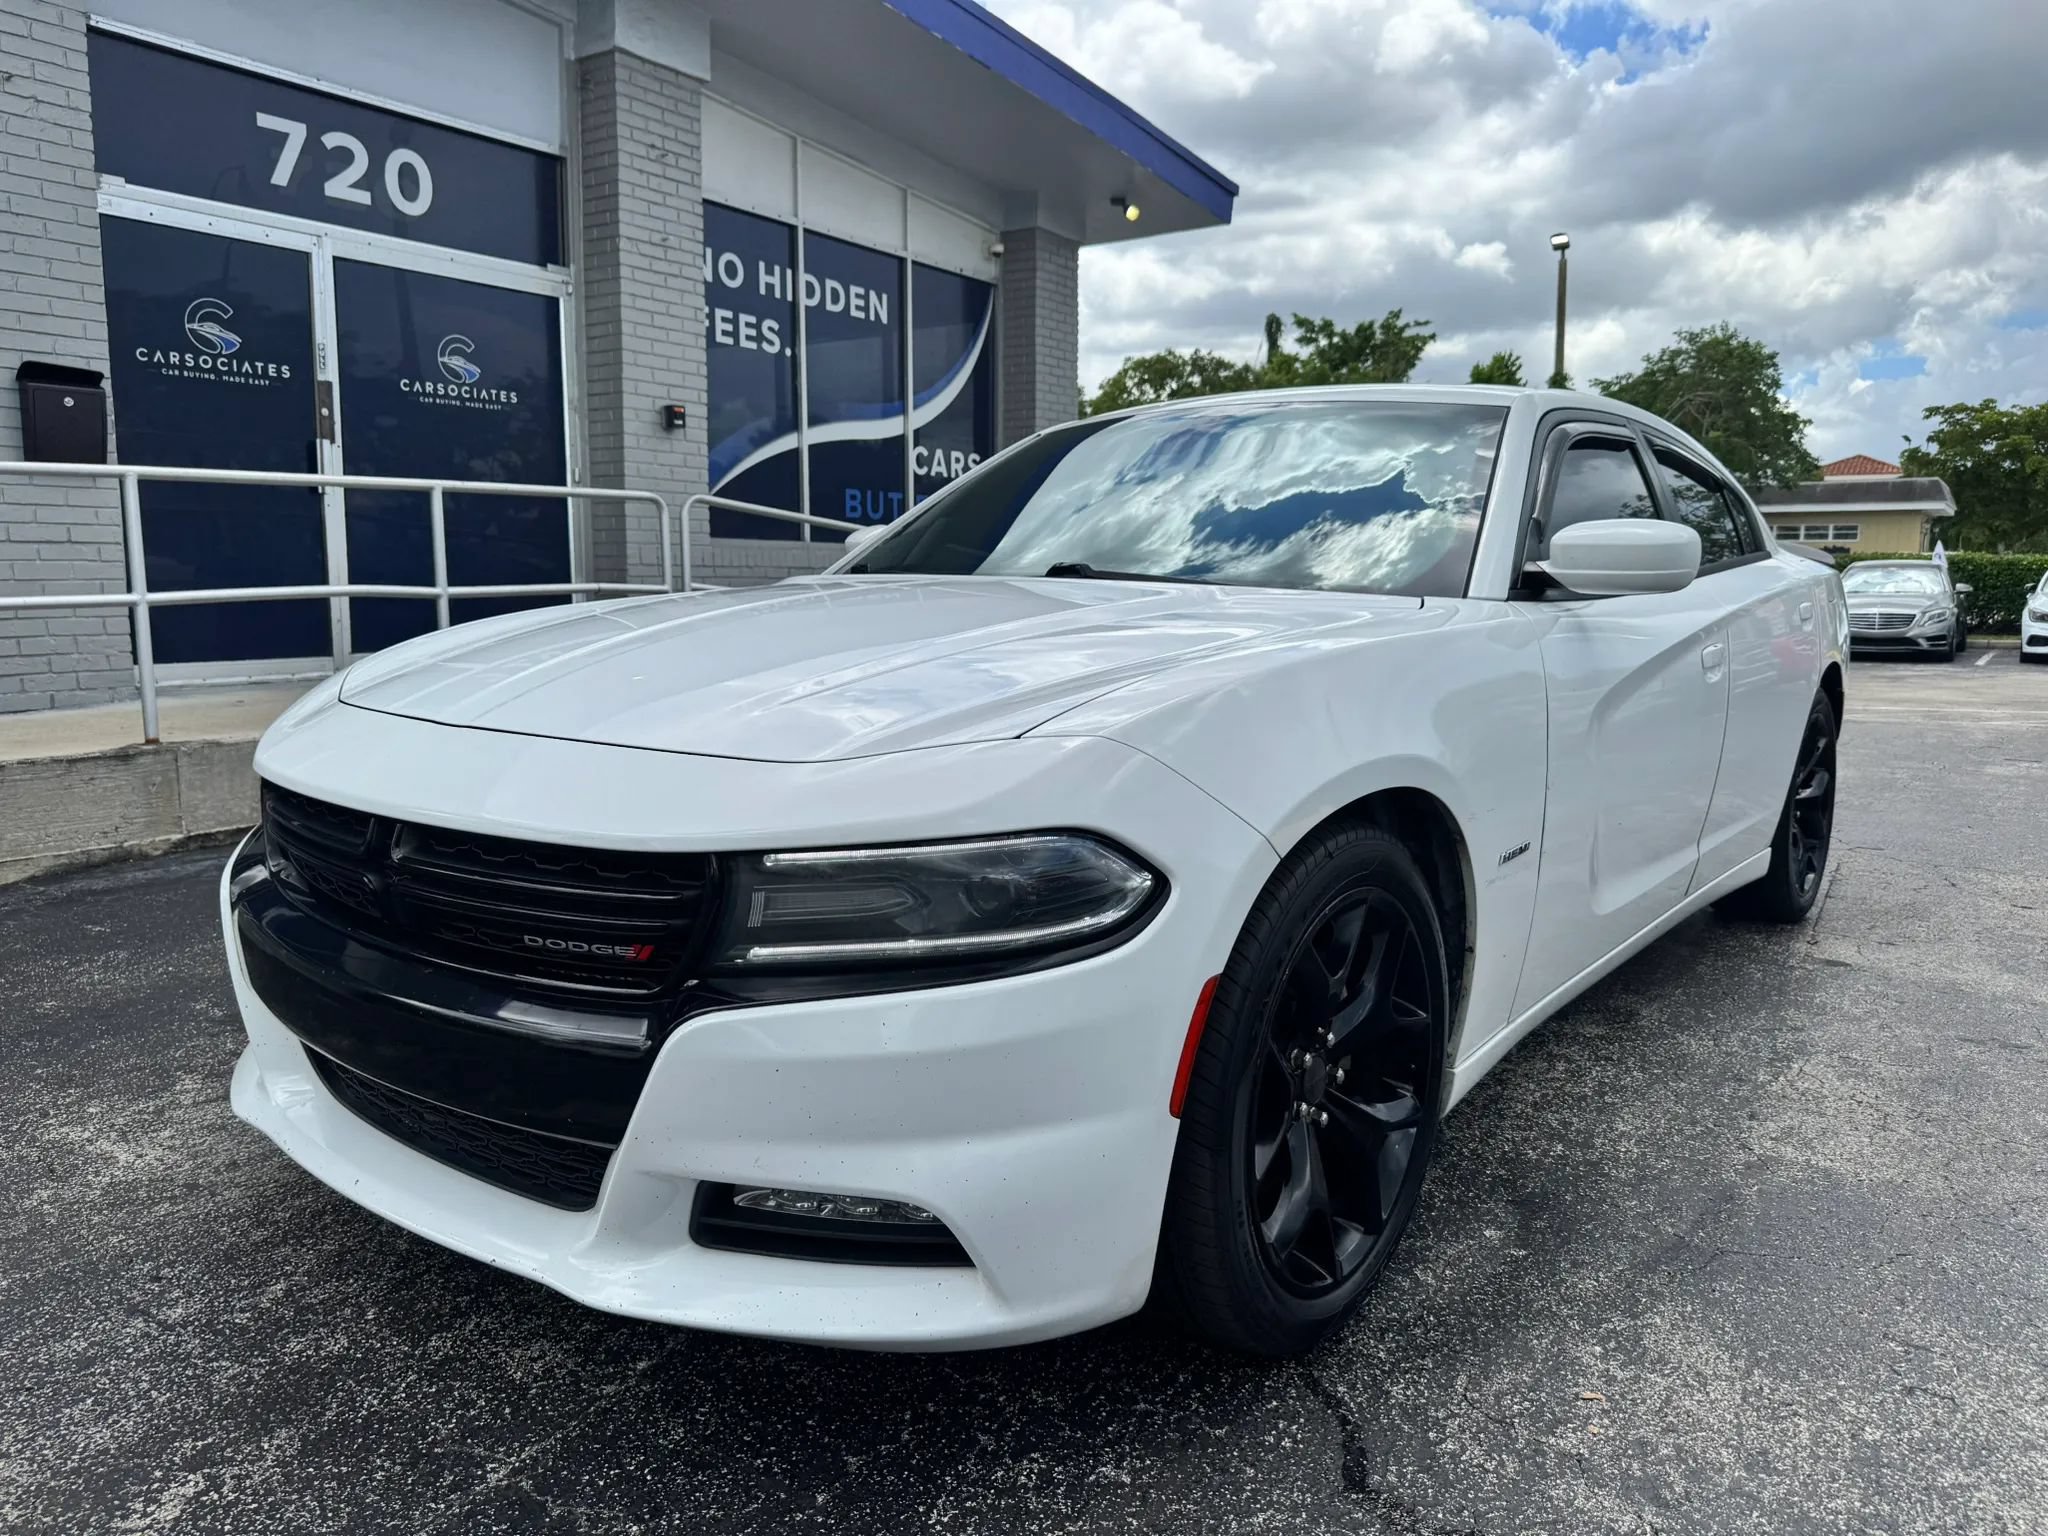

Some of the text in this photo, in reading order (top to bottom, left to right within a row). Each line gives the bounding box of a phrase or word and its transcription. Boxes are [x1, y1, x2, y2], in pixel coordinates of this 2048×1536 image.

[255, 111, 434, 217] 720
[758, 260, 888, 325] HIDDEN
[703, 305, 792, 357] EES.
[135, 347, 292, 379] CARSOCIATES
[161, 367, 180, 376] CAR
[222, 375, 245, 384] MADE
[249, 378, 270, 387] EASY
[400, 379, 518, 404] CARSOCIATES
[845, 488, 903, 521] BUT
[523, 935, 637, 957] DODGE
